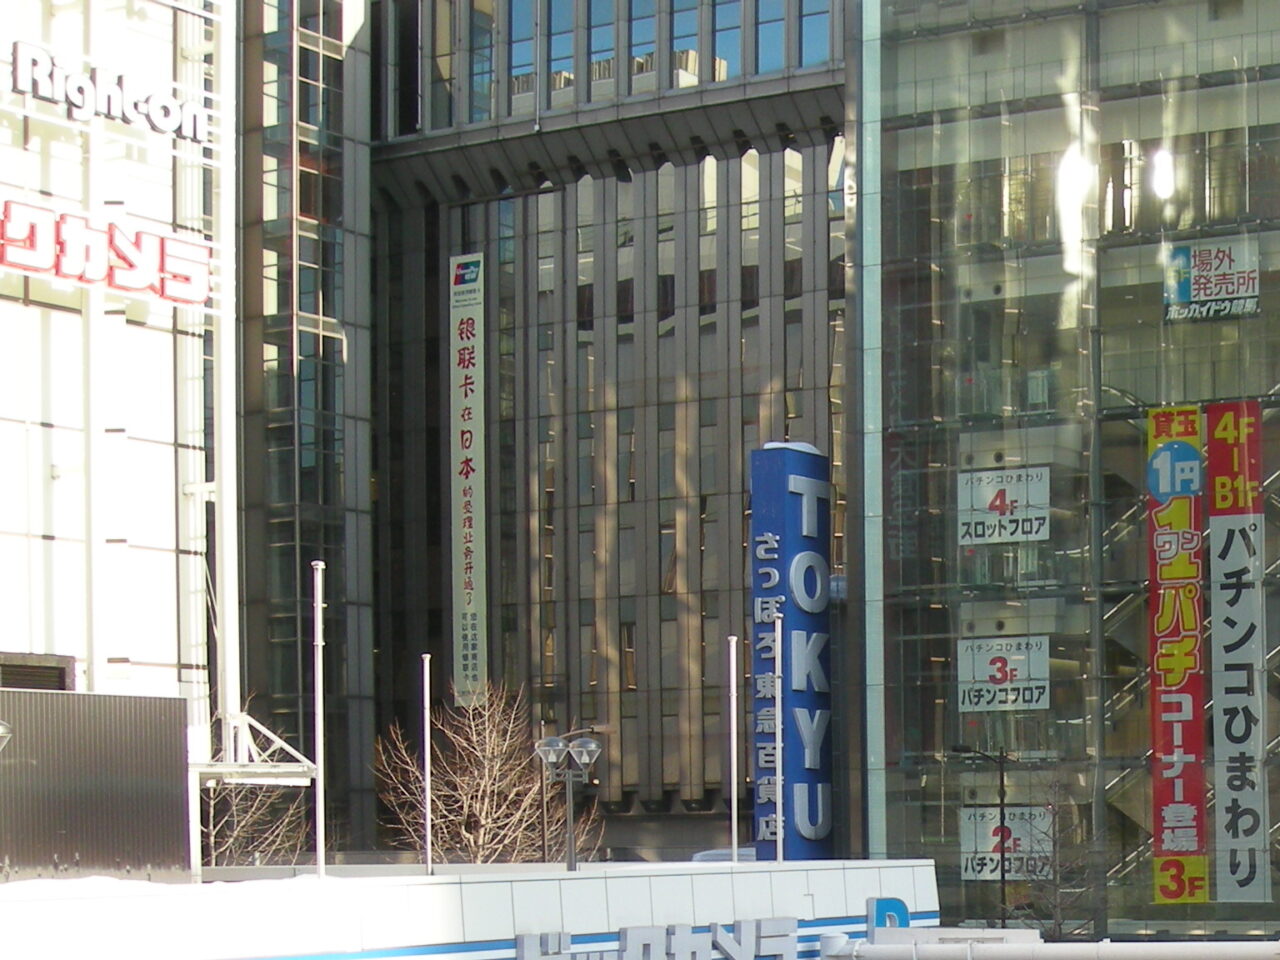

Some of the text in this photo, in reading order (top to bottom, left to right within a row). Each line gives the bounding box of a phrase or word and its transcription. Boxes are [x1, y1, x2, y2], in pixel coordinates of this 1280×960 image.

[1192, 246, 1235, 273] 場外
[1192, 269, 1257, 298] 発売所
[1152, 409, 1198, 439] 貸玉
[1214, 411, 1255, 443] 4F
[1152, 451, 1199, 492] 1円
[987, 488, 1018, 517] 4F
[1215, 475, 1259, 509] B1F
[960, 515, 1046, 540] スロットフロア
[788, 474, 832, 841] TOKYU
[988, 656, 1018, 685] 3F
[960, 684, 1046, 706] パチンコフロア
[1218, 523, 1260, 889] パチンコひまわり
[991, 825, 1021, 854] 2F
[963, 853, 1051, 876] パチンコフロア
[1159, 860, 1205, 899] 3F
